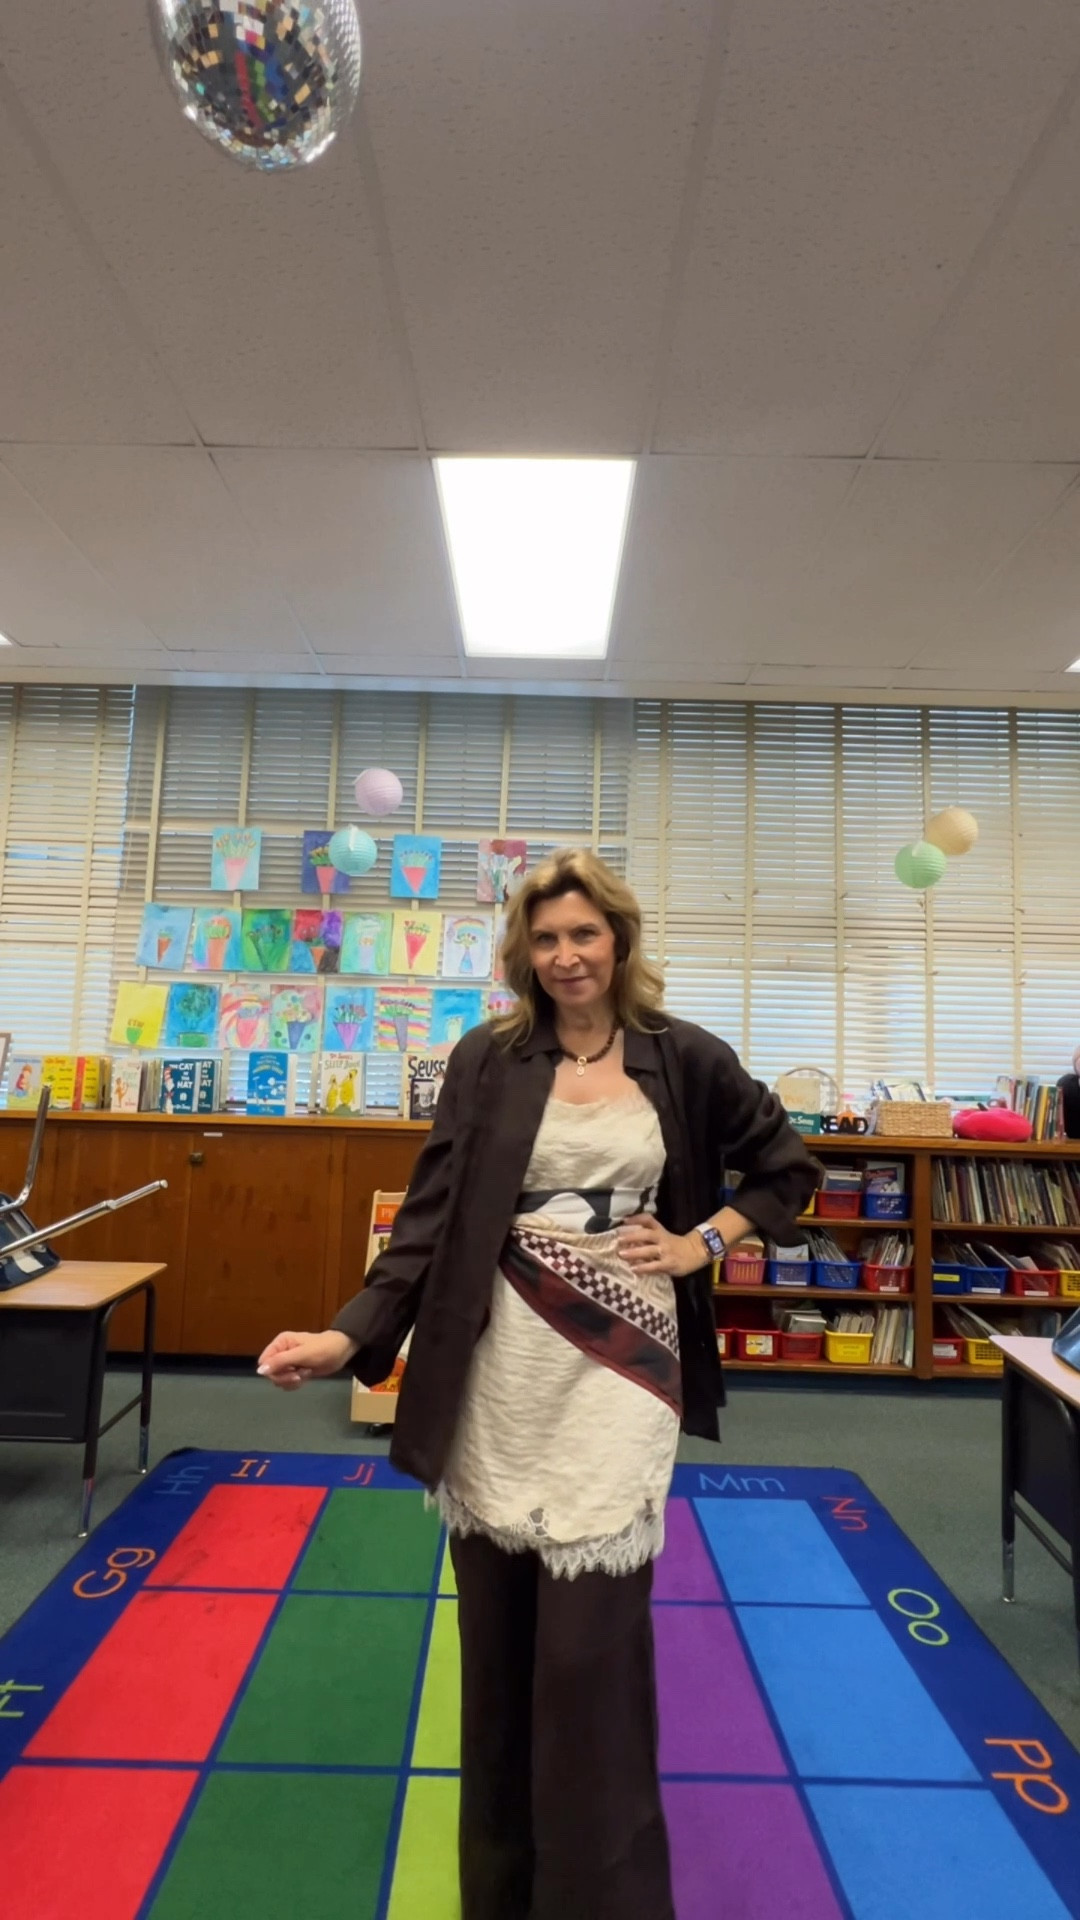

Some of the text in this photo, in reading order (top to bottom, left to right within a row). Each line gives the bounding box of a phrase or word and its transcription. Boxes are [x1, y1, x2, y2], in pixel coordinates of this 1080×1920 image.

[179, 1062, 194, 1070] CAT
[408, 1056, 446, 1078] Seuss
[153, 1466, 209, 1496] Hh
[343, 1463, 376, 1485] Jj
[698, 1472, 786, 1492] Mm
[72, 1547, 156, 1599] Gg
[887, 1588, 950, 1646] Oo
[985, 1738, 1070, 1815] Pp
